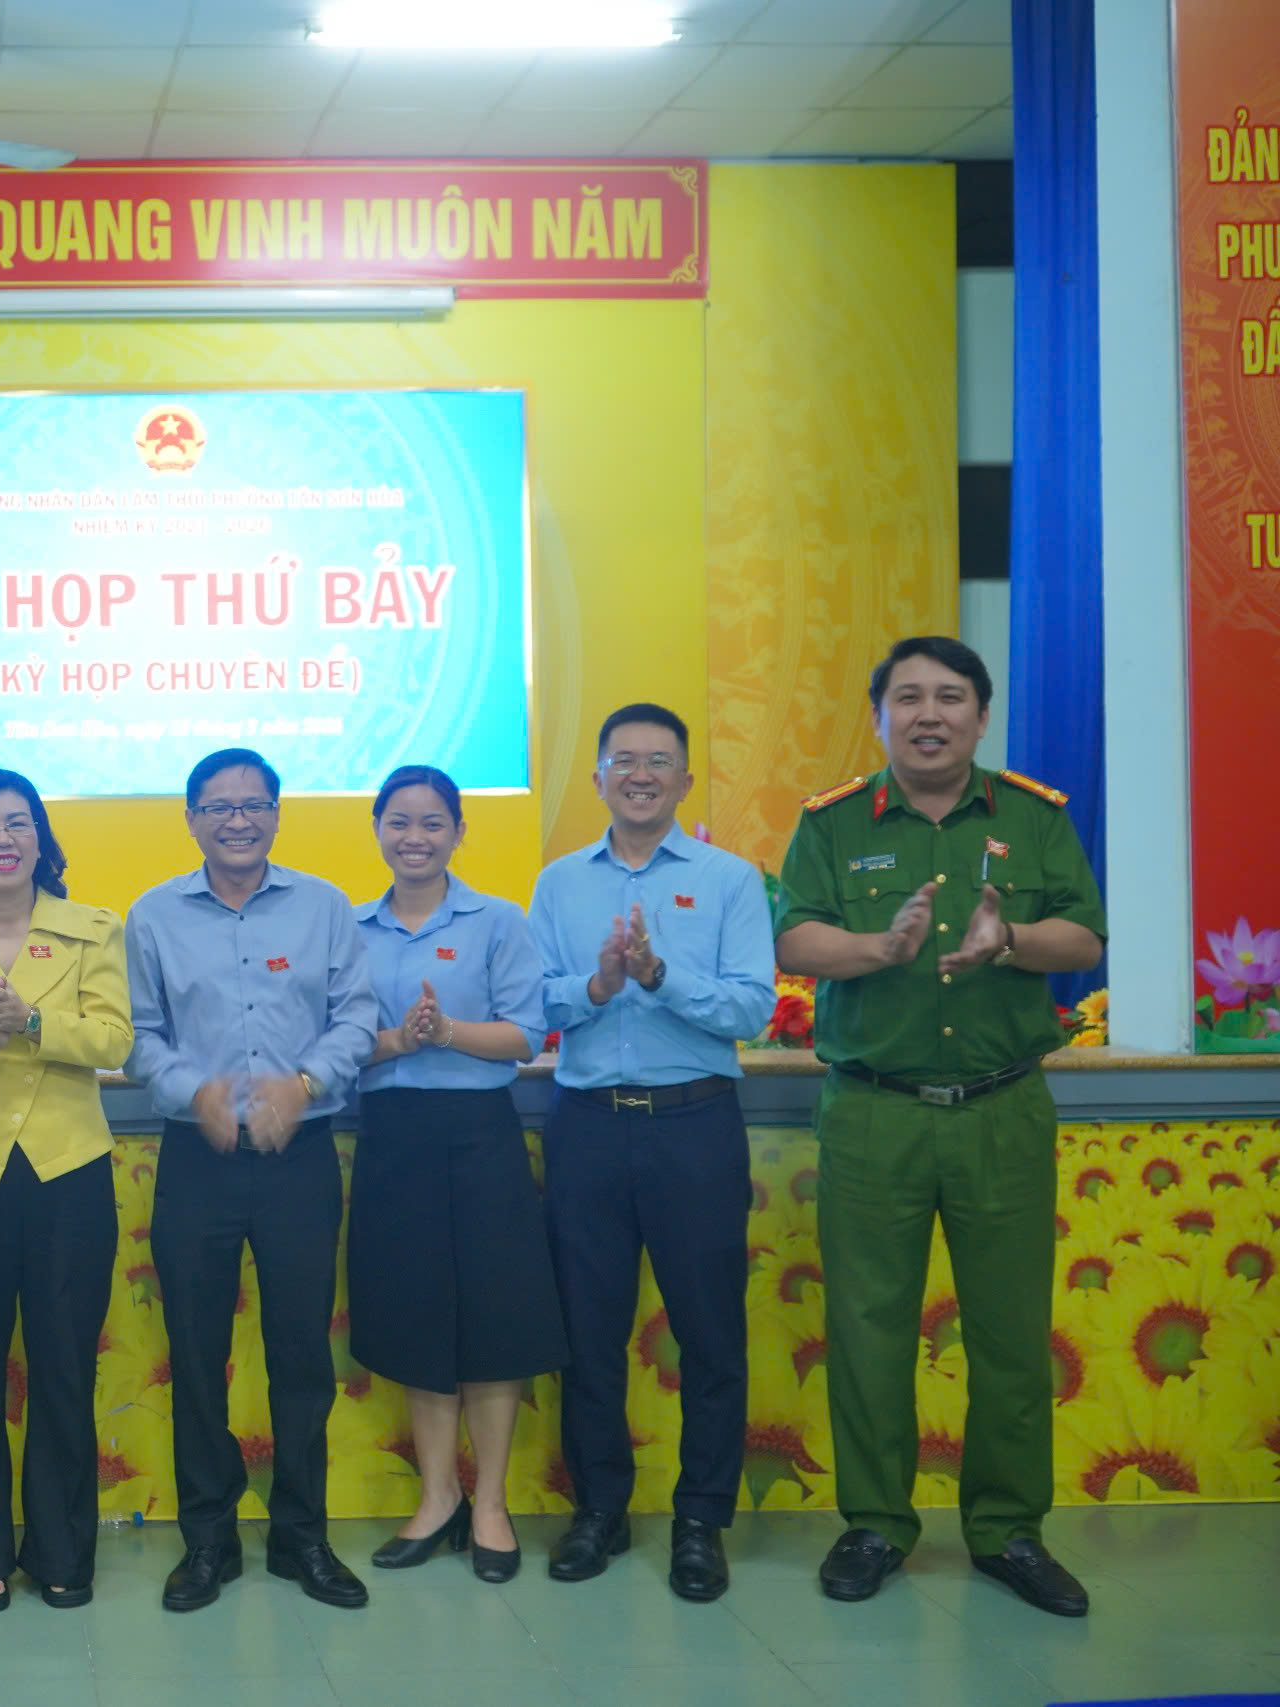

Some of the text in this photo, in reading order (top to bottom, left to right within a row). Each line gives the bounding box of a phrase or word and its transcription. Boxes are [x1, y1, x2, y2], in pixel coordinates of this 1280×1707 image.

[190, 199, 324, 261] VINH
[344, 184, 513, 260] MUÔN
[532, 184, 663, 260] NĂM
[5, 573, 136, 642] HỌP
[160, 555, 298, 627] THỨ
[323, 546, 449, 625] BẢY
[61, 662, 132, 700] HỌP
